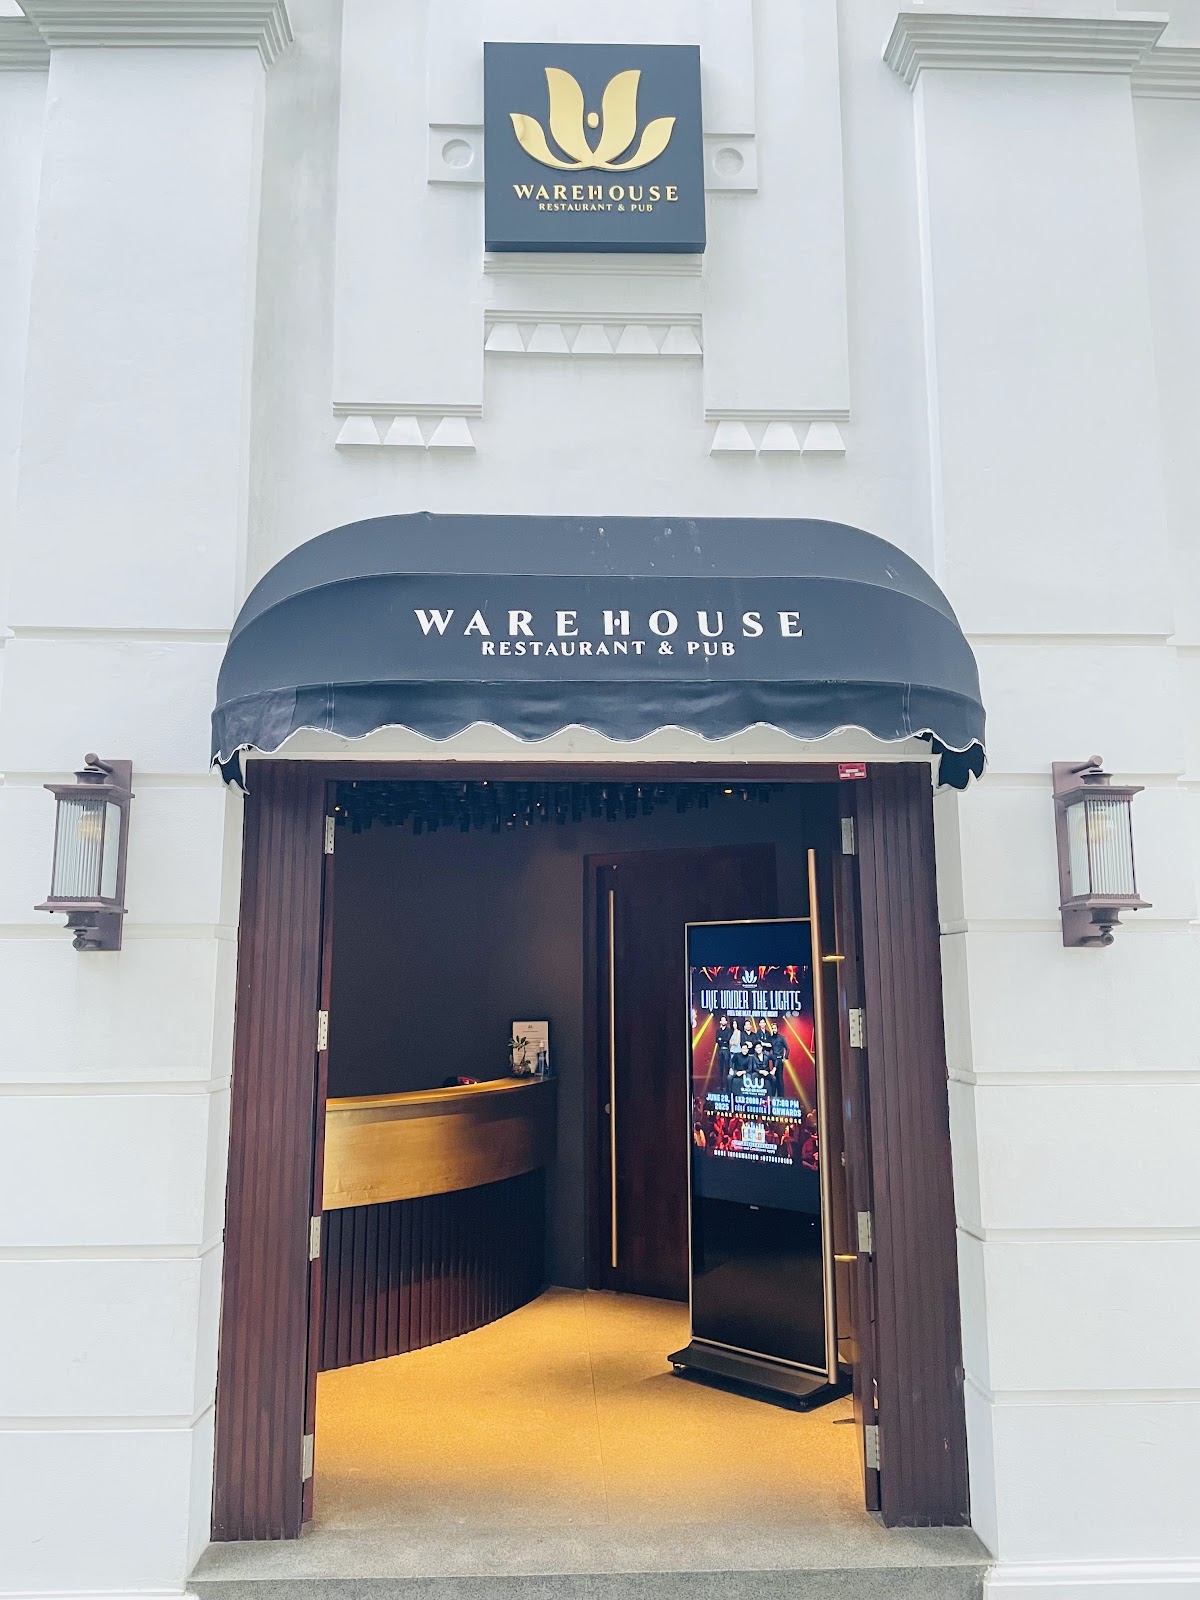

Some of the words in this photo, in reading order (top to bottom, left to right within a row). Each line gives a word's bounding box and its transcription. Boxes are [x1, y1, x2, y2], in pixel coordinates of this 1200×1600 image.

[513, 184, 679, 201] WAREHOUSE
[539, 203, 612, 212] RESTAURANT
[617, 203, 625, 212] &
[631, 204, 653, 213] PUB
[414, 608, 803, 638] WAREHOUSE
[481, 640, 646, 656] RESTAURANT
[658, 641, 674, 656] &
[687, 641, 736, 656] PUB
[701, 990, 718, 1011] LIVE
[720, 990, 749, 1010] UNDER
[752, 990, 768, 1010] THE
[770, 990, 801, 1010] LIGHTS
[706, 1093, 720, 1102] JUNE
[772, 1107, 801, 1117] ONWARDS
